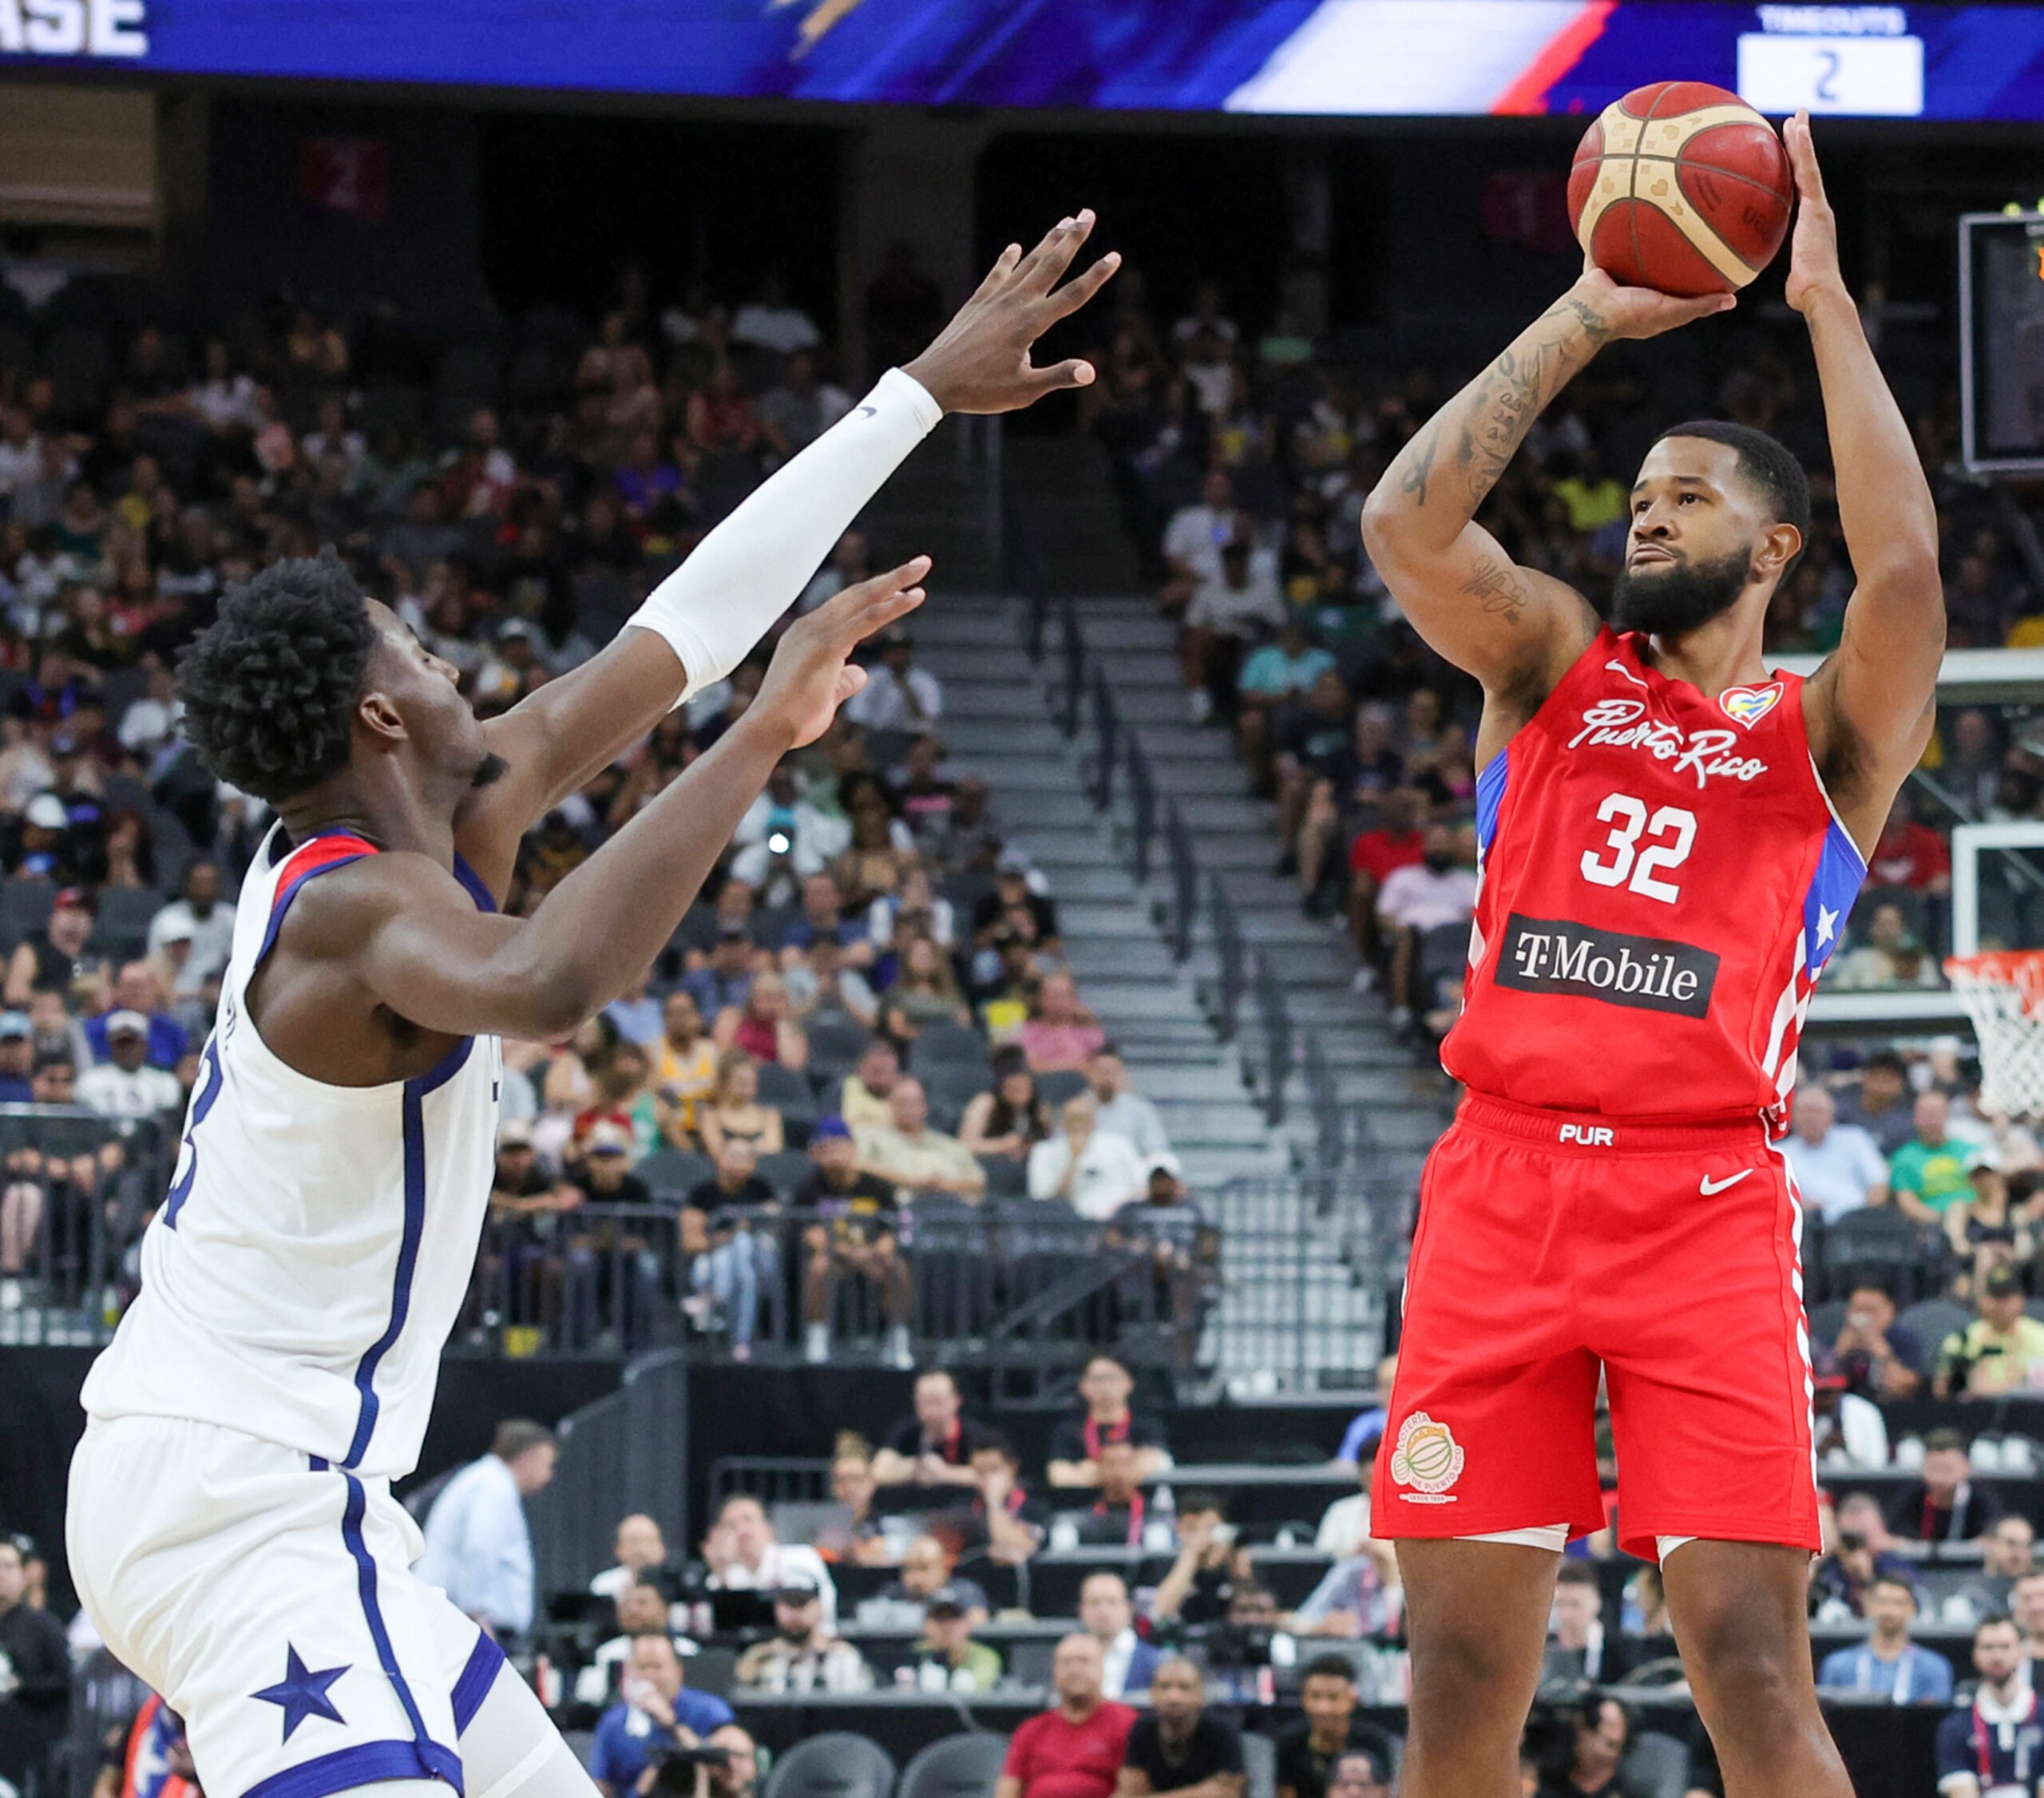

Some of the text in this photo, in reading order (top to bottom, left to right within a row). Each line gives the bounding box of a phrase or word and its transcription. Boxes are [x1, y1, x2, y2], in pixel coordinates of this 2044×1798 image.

[1816, 50, 1839, 101] 2
[1567, 699, 1768, 790] Puerto Rico
[1580, 792, 1697, 905] 32
[1559, 1123, 1614, 1147] PUR
[1399, 1412, 1429, 1448] LOTERÍA
[1411, 1448, 1462, 1491] DE PUERTO RICO
